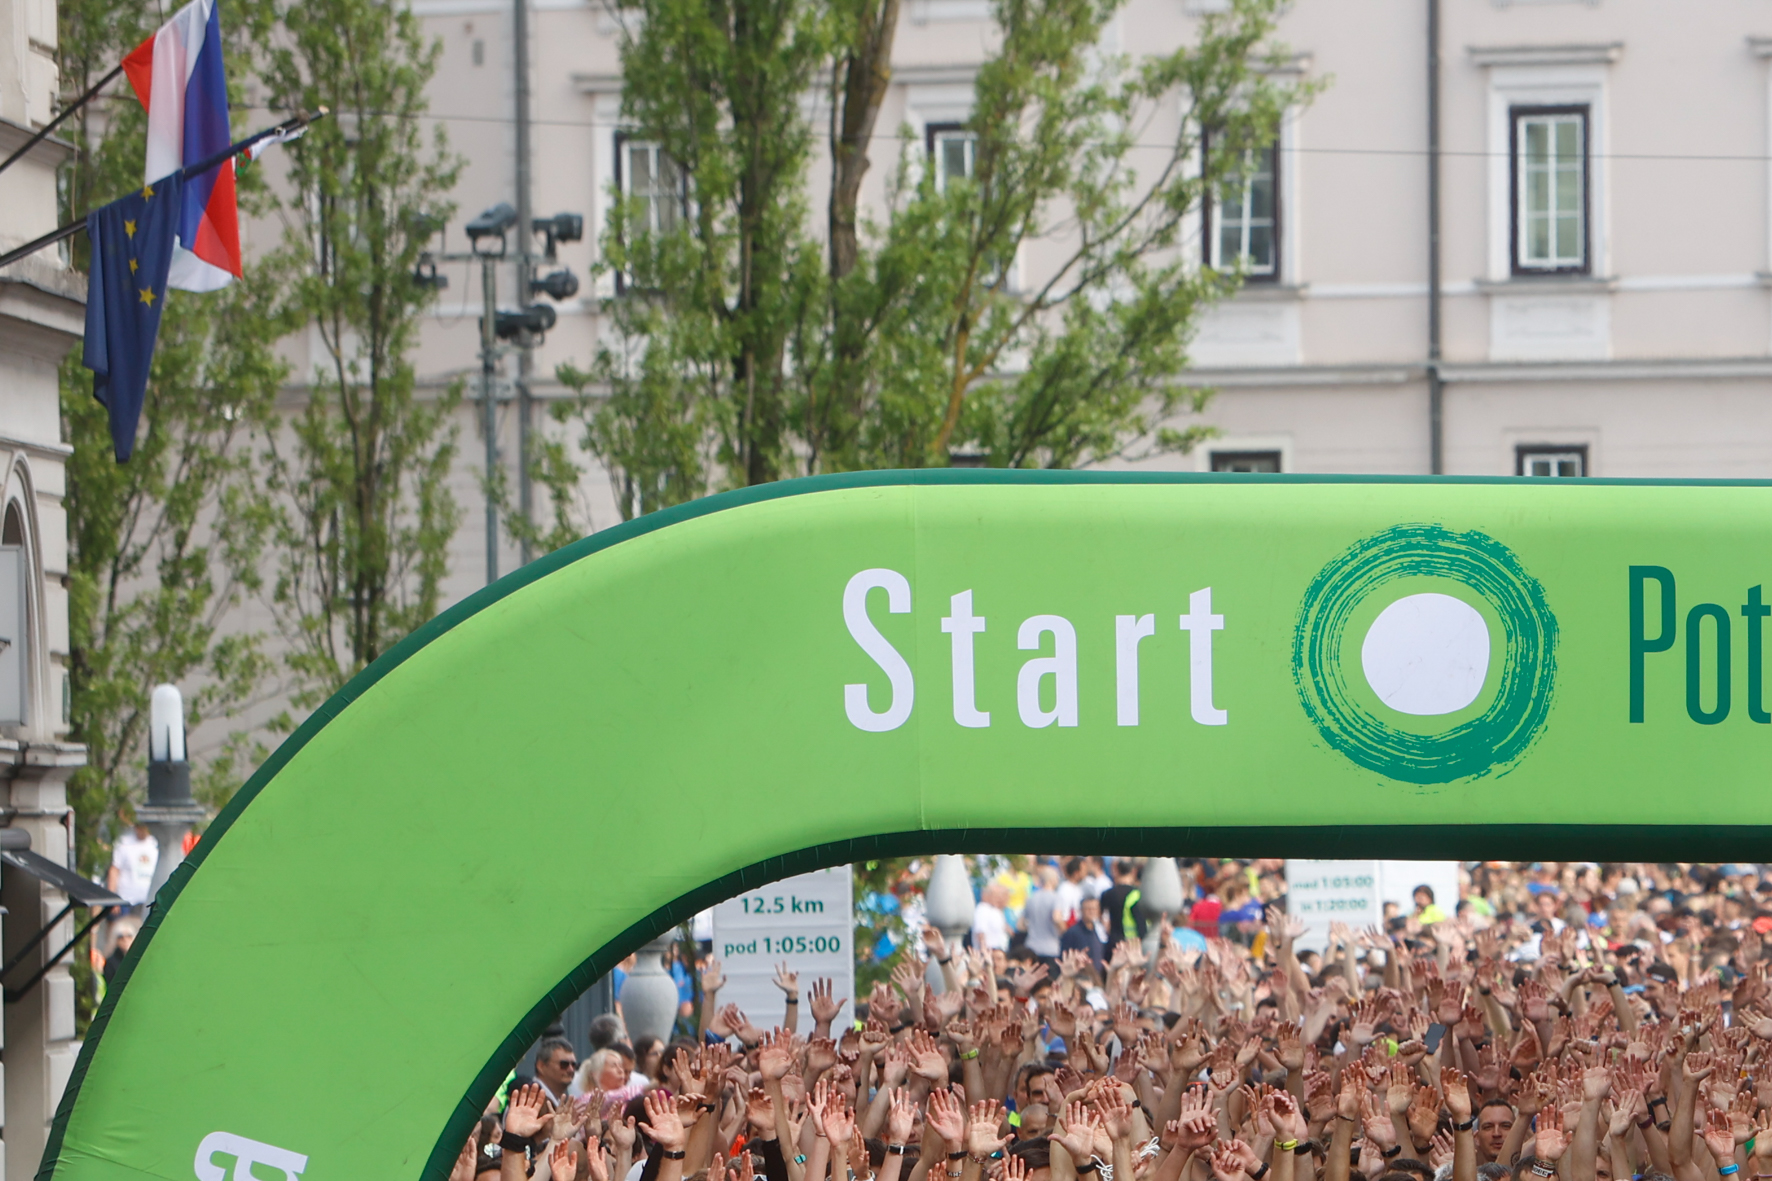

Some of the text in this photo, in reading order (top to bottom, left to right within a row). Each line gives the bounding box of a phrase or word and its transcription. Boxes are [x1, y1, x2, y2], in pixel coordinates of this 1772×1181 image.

[841, 567, 1229, 733] Start
[1628, 564, 1772, 727] Pot
[724, 936, 841, 957] pod 1:05:00
[741, 896, 824, 914] 12.5 km
